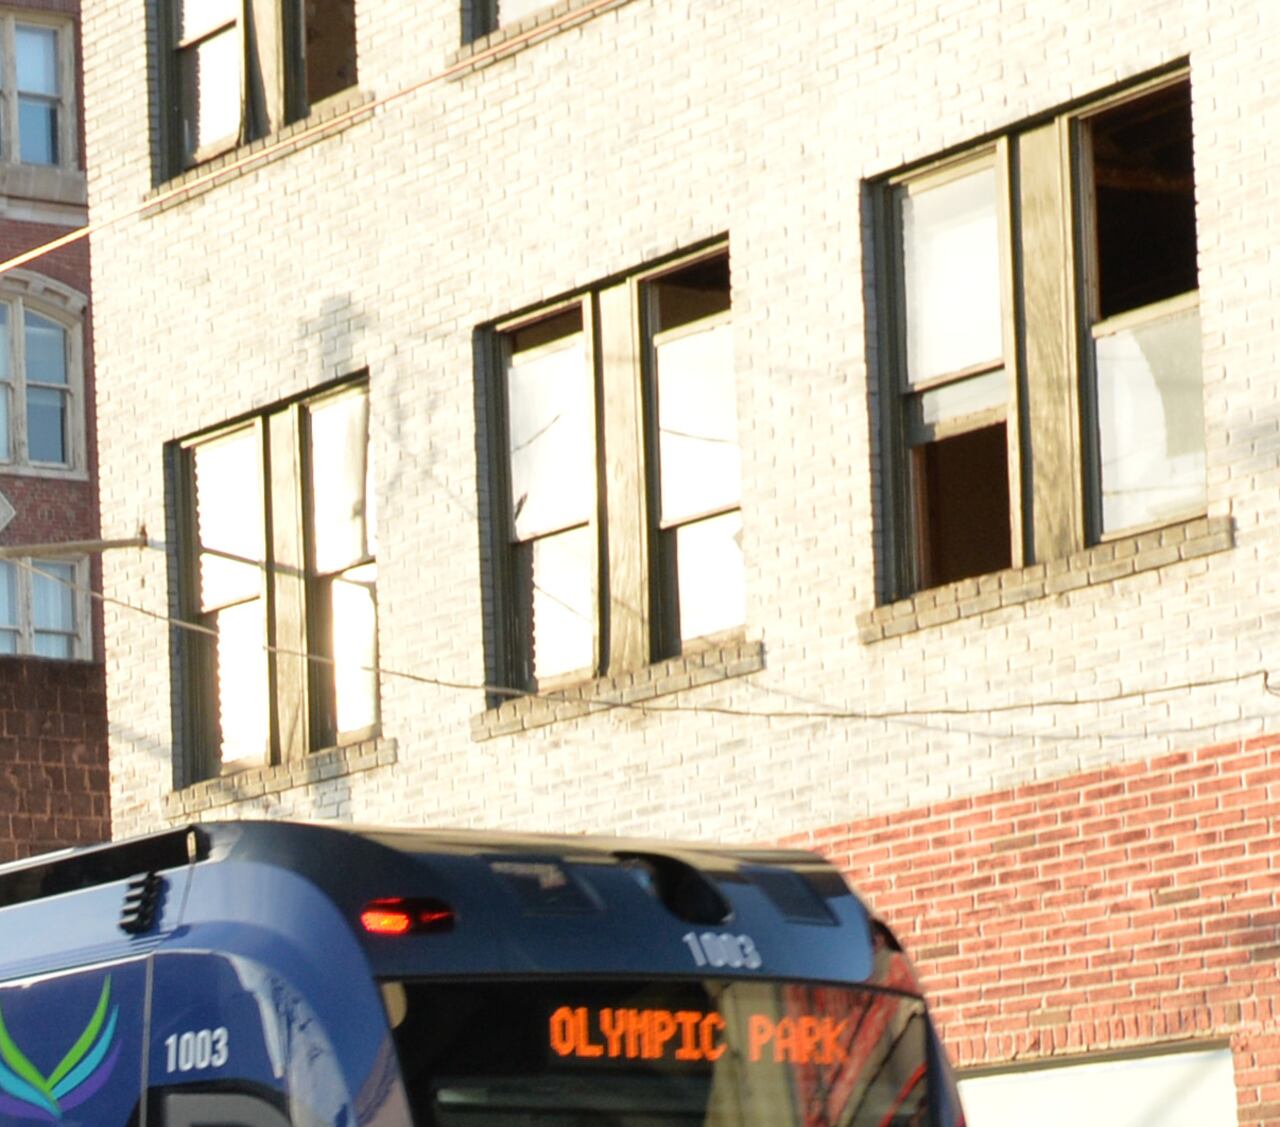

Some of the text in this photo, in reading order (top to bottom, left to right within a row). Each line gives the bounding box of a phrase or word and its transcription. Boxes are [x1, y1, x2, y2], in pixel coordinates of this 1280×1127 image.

[682, 931, 763, 969] 1003
[164, 1026, 229, 1074] 1003
[549, 1006, 850, 1065] OLYMPIC PARK
